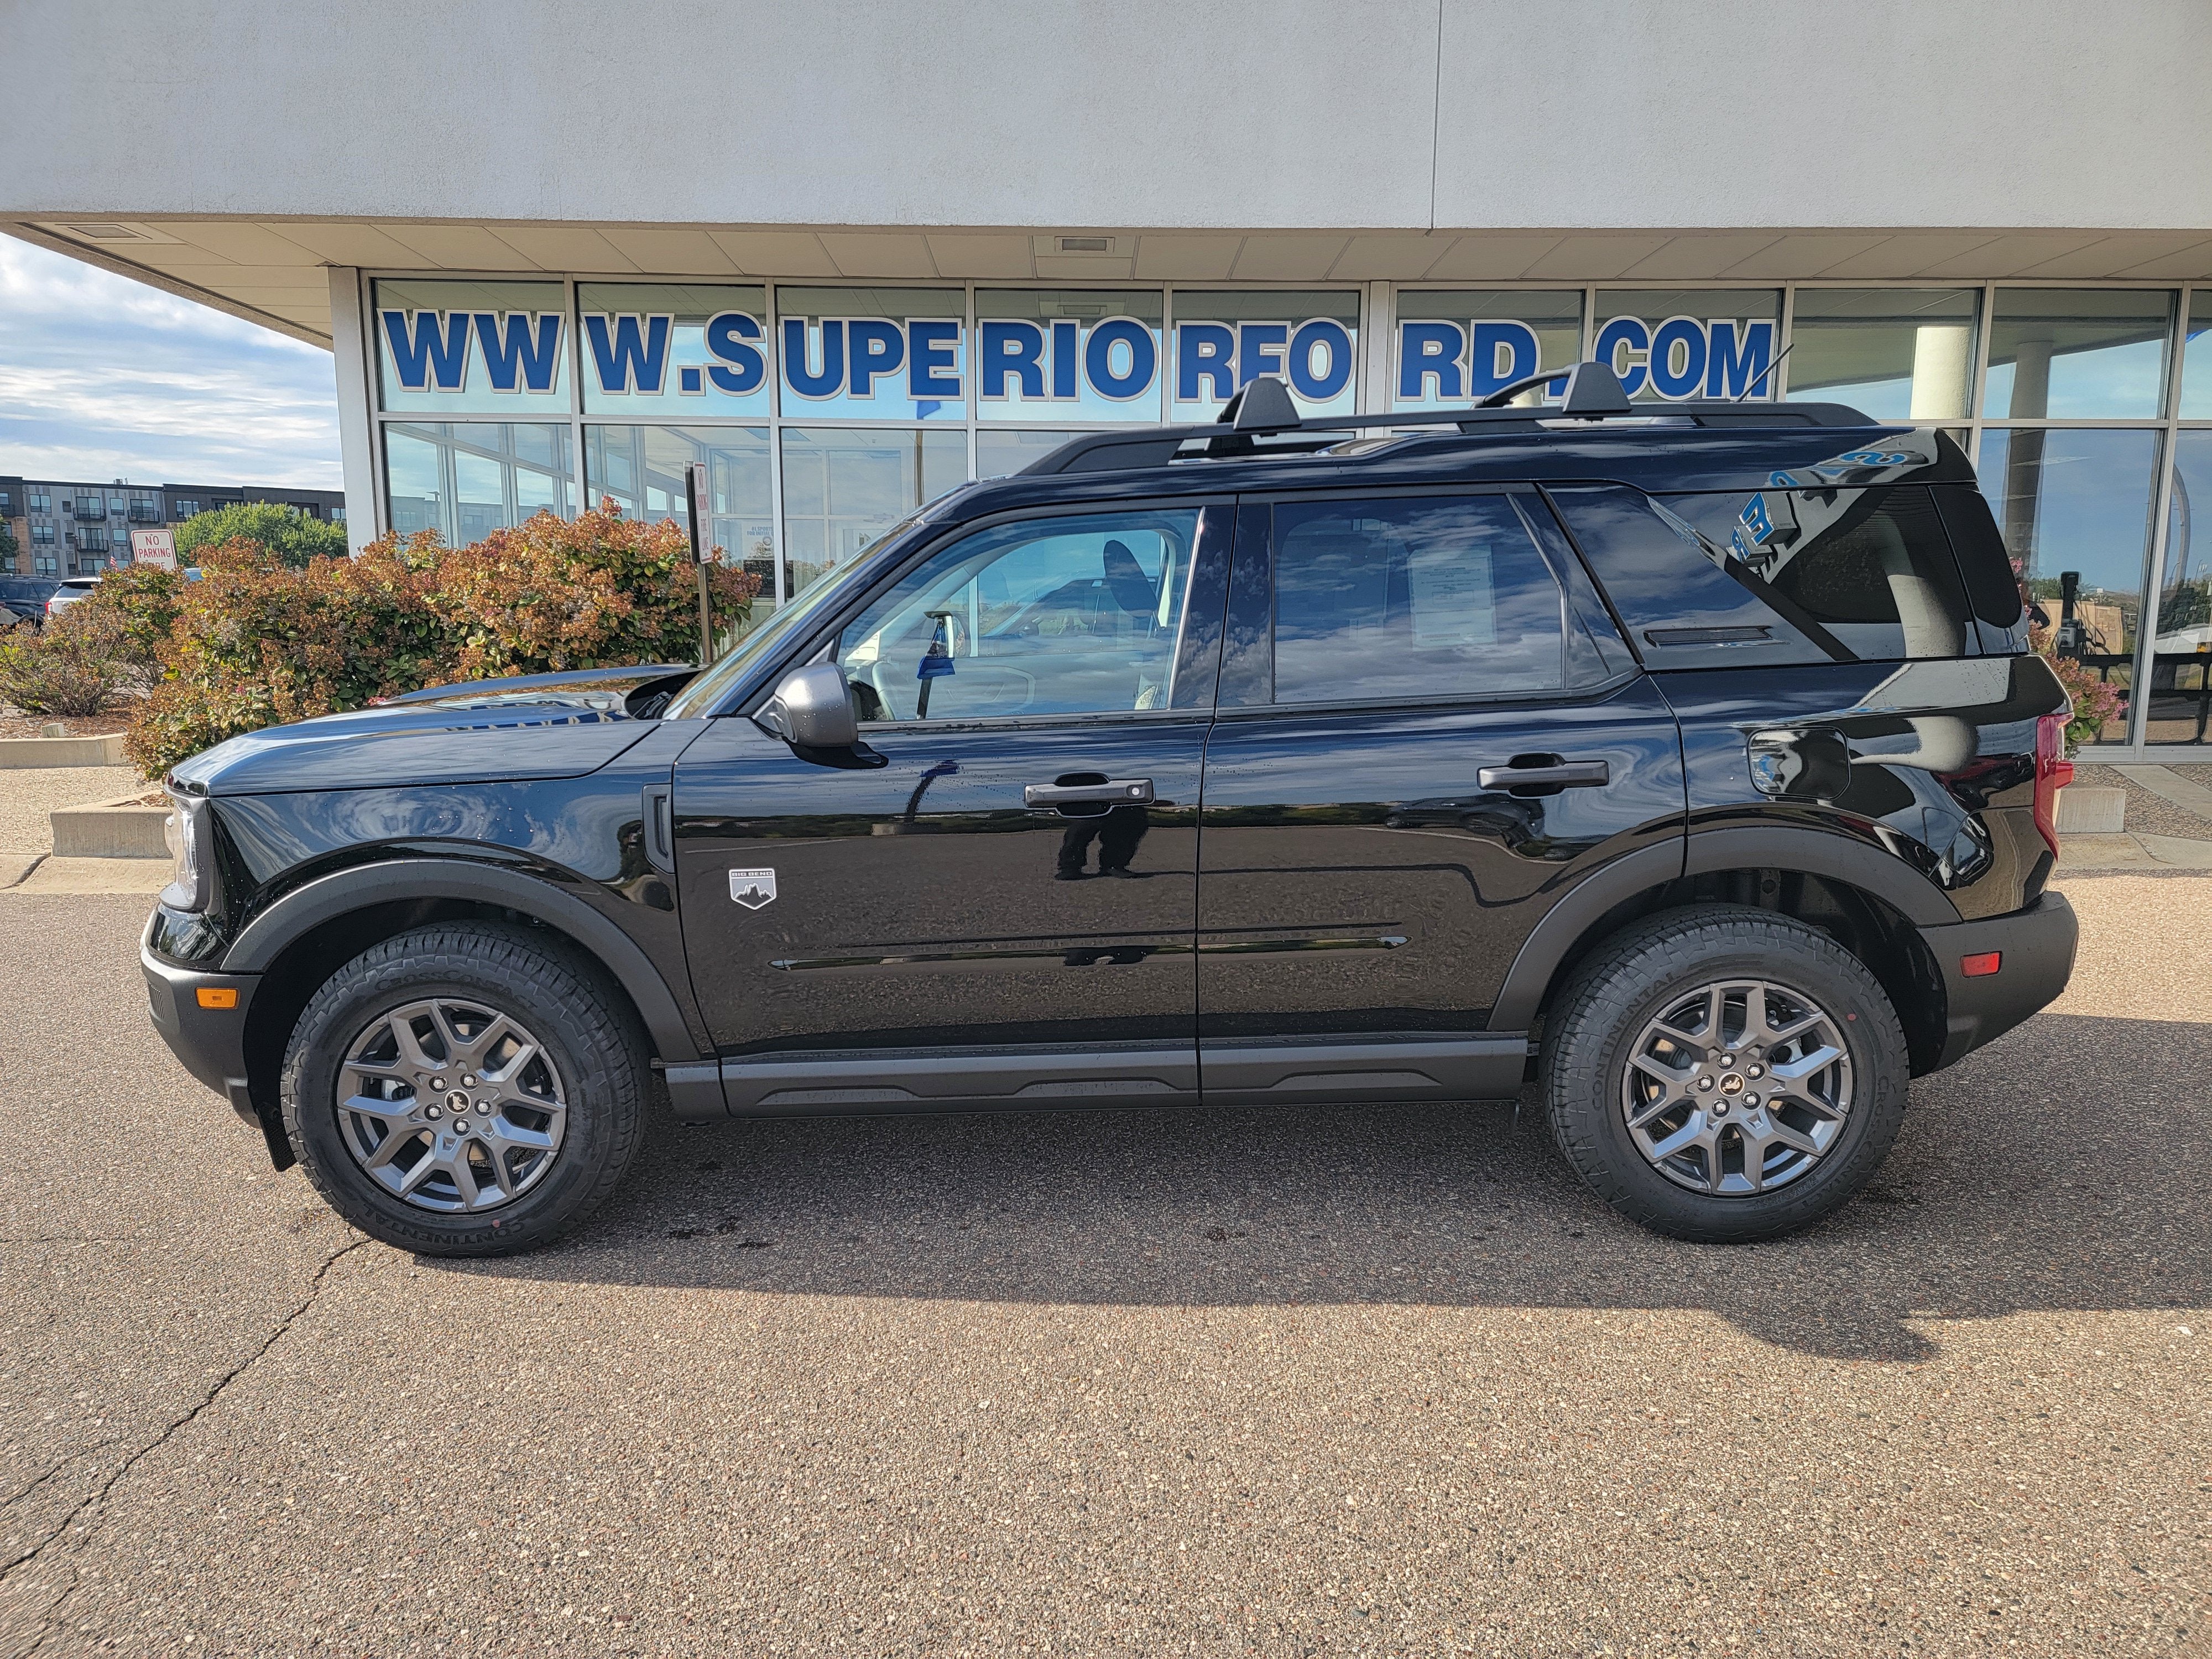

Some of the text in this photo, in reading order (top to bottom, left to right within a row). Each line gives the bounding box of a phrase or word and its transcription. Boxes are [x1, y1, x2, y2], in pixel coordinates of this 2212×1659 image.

[139, 548, 171, 558] PARKING
[145, 536, 159, 545] NO
[1592, 972, 1681, 1112] CONTINENTAL
[363, 1203, 524, 1245] CONTINENTAL
